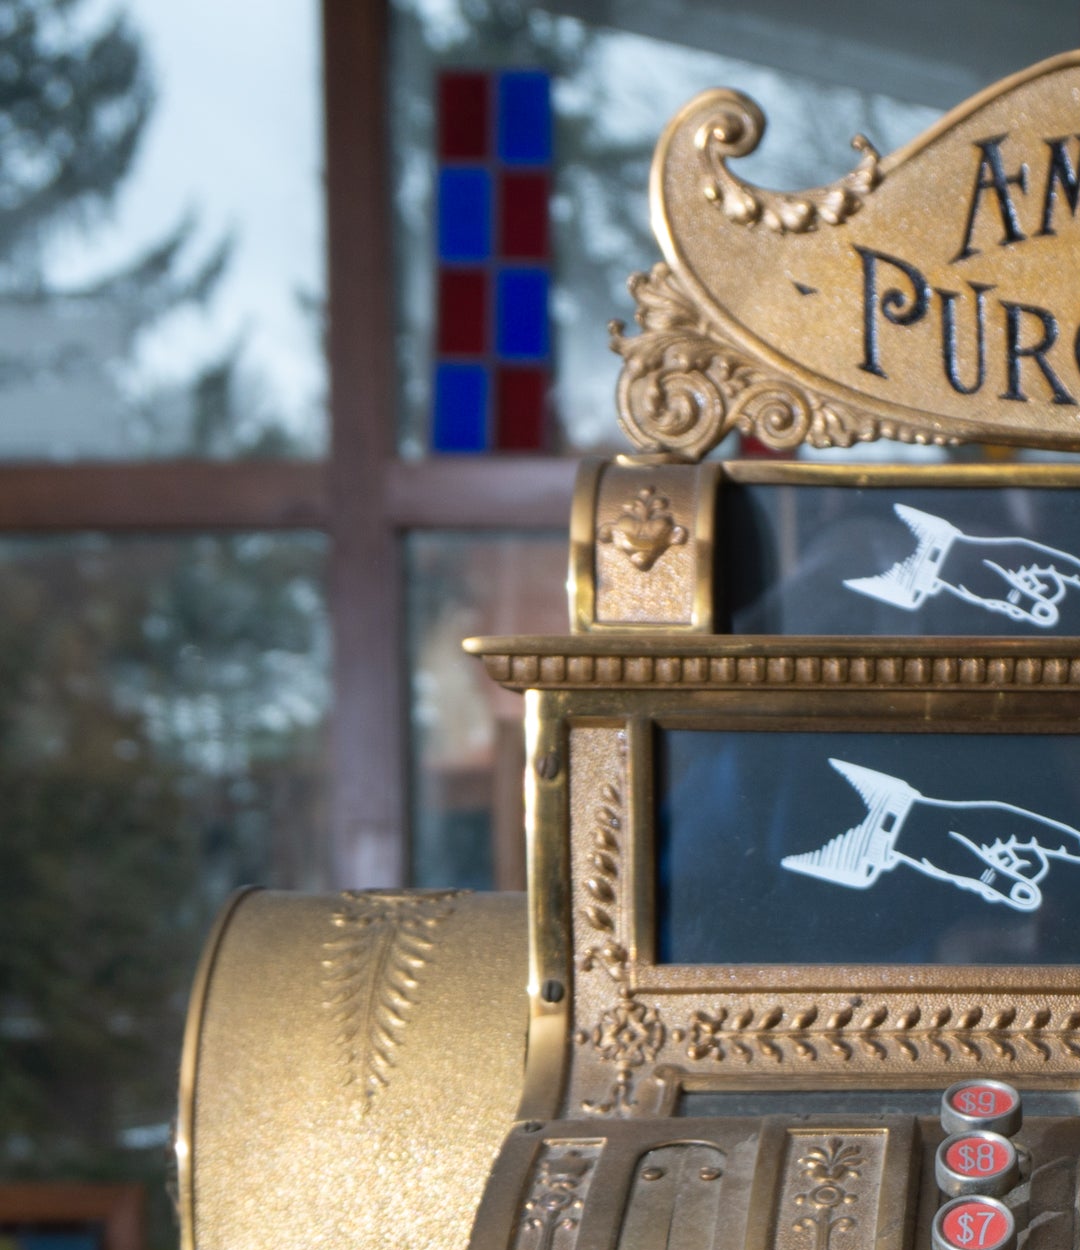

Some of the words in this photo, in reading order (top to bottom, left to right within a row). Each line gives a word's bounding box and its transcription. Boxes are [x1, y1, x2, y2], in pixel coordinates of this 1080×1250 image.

[960, 1091, 996, 1115] $9
[958, 1144, 994, 1172] $8
[957, 1212, 995, 1245] $7
